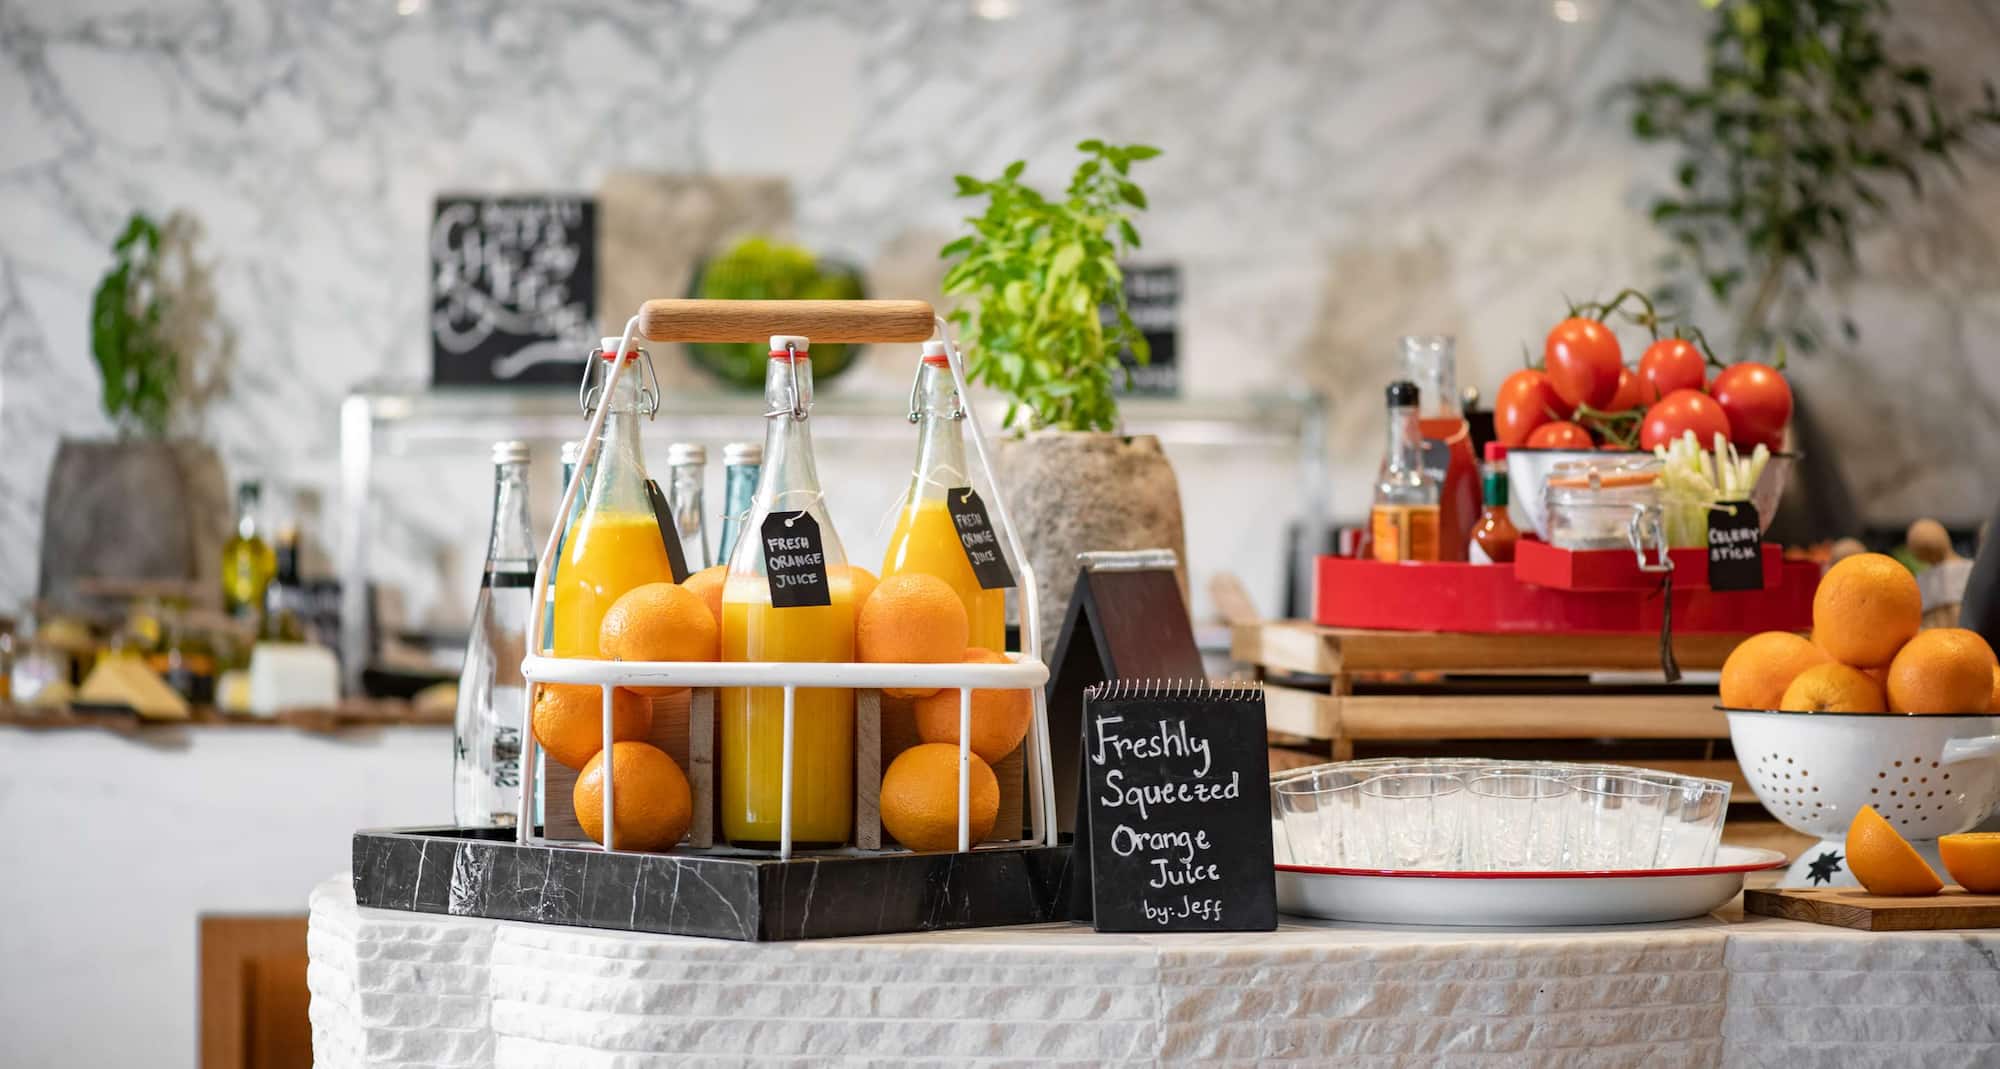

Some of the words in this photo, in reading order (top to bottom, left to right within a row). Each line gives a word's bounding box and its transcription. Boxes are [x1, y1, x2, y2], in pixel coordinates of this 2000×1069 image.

[767, 536, 810, 552] FRESH
[769, 552, 822, 570] ORANGE
[775, 572, 818, 589] JUICE
[1091, 715, 1210, 777] Freshly
[1101, 769, 1239, 819] Squeezed
[1111, 823, 1212, 863] Orange
[1150, 859, 1221, 889] Juice
